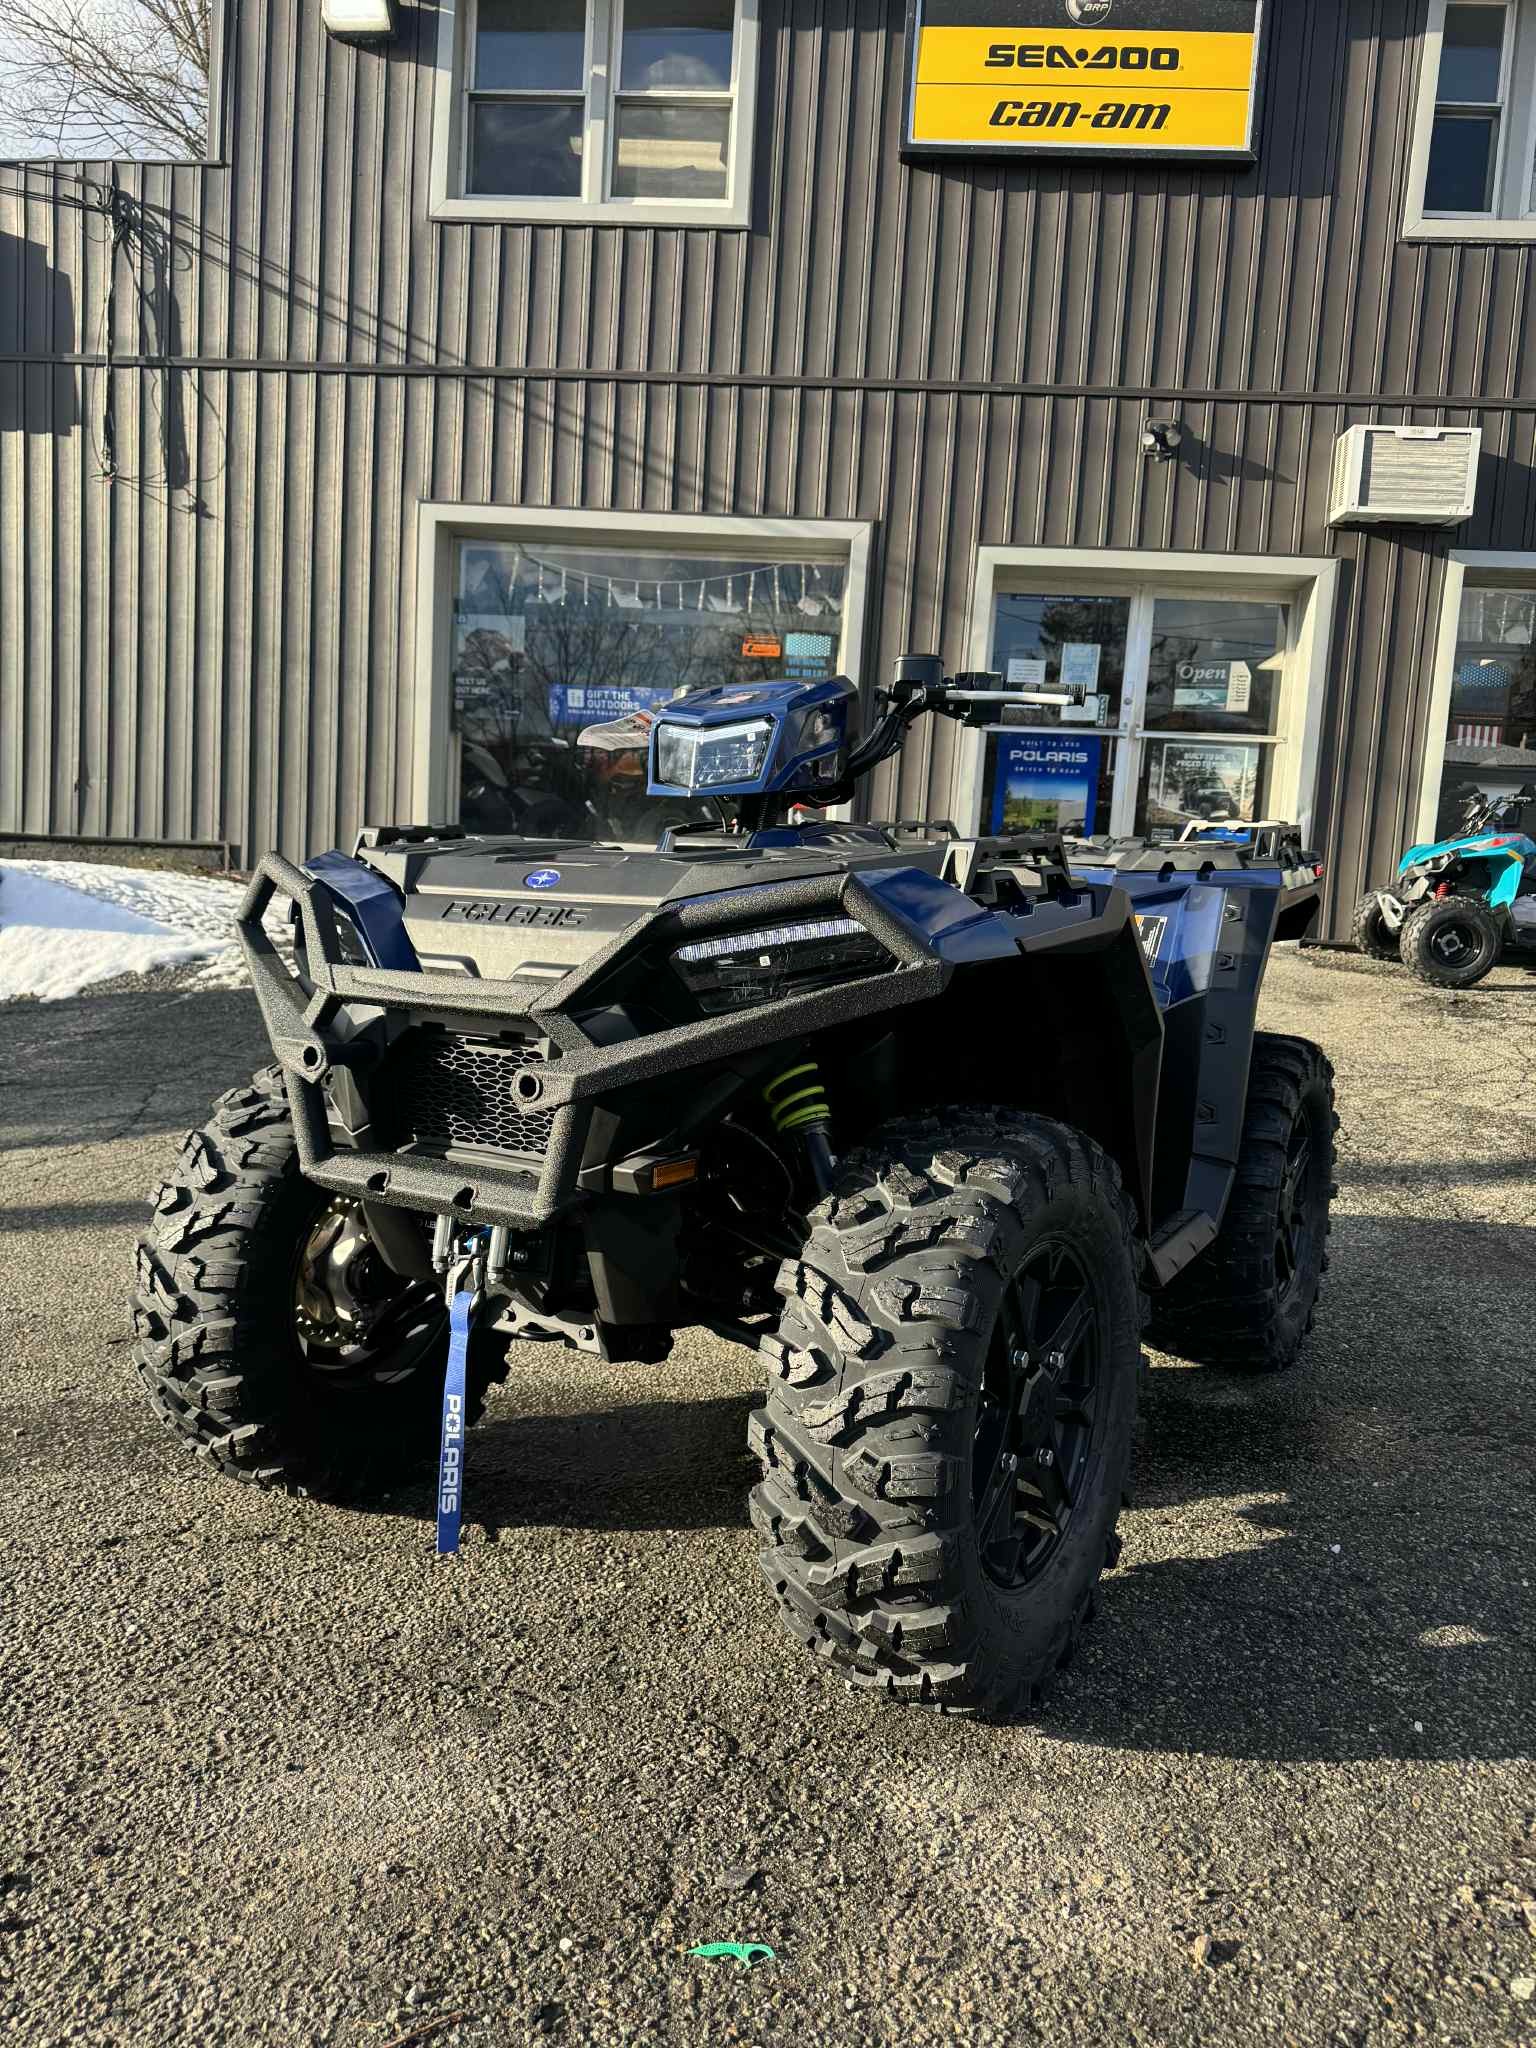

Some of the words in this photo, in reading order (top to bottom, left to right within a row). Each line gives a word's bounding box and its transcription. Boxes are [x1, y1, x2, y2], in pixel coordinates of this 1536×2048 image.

[1179, 665, 1227, 684] Open
[587, 690, 610, 700] GIFT
[611, 690, 631, 701] THE
[587, 699, 640, 710] OUTDOORS
[1009, 750, 1088, 763] POLARIS
[442, 901, 590, 926] POLARIS
[441, 1394, 462, 1514] POLARIS
